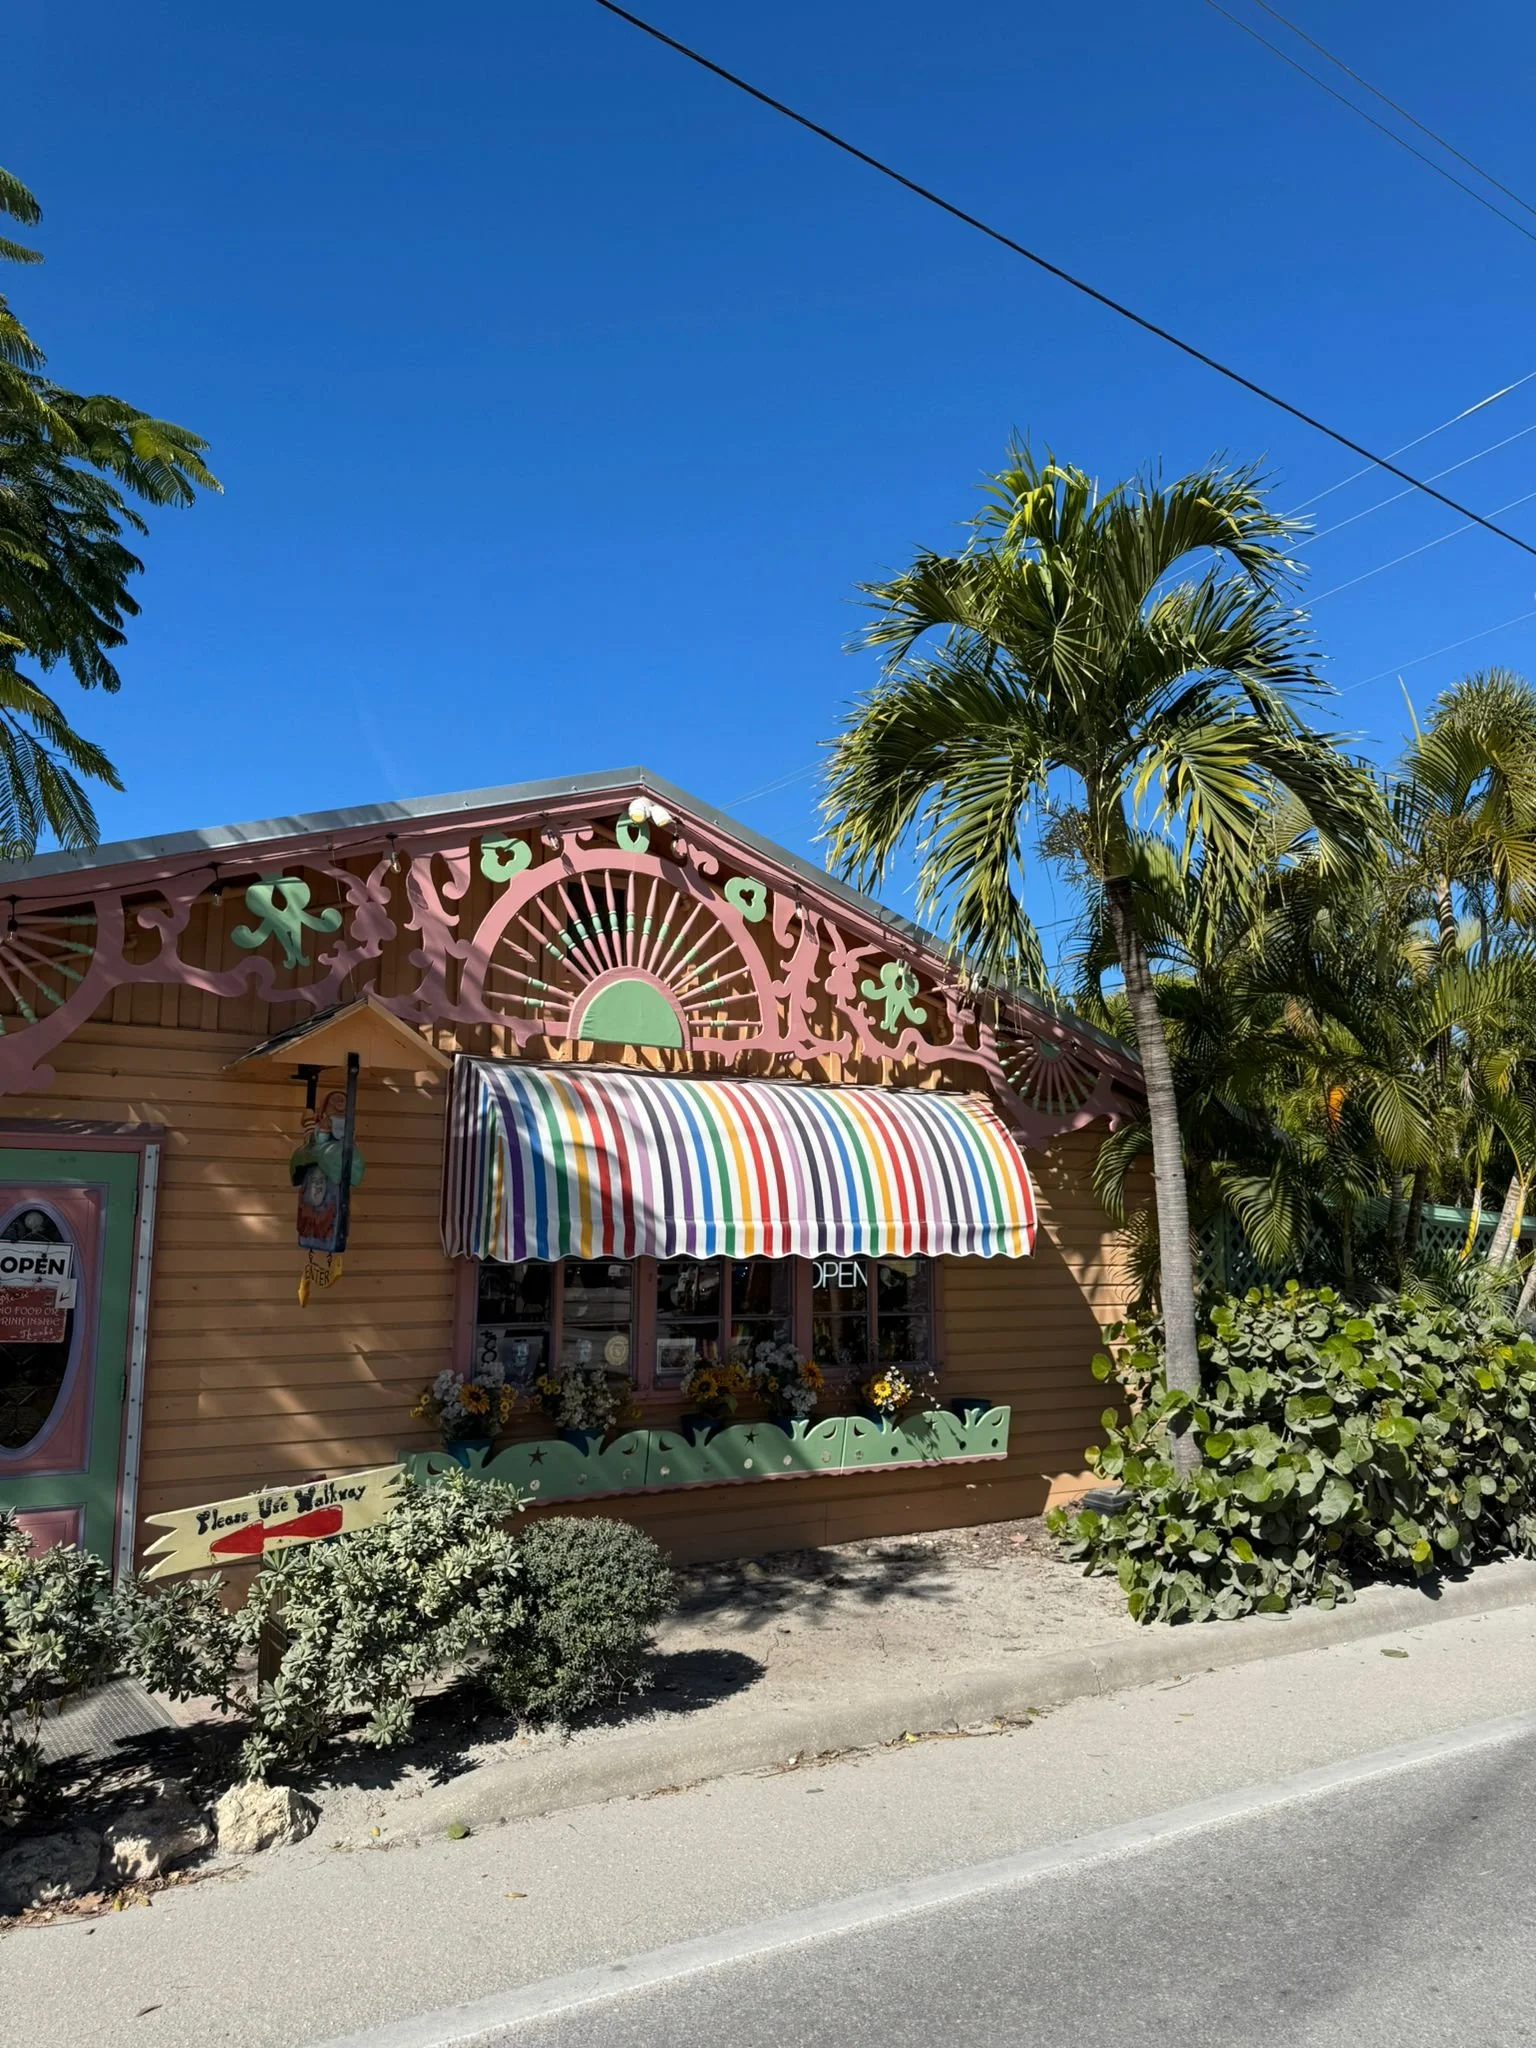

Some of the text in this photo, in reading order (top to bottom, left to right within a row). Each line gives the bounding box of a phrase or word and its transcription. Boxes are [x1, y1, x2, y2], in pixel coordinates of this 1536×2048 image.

[0, 1256, 65, 1275] OPEN
[305, 1263, 330, 1287] ENTER
[15, 1306, 42, 1315] FOOD
[0, 1316, 25, 1327] RINK
[196, 1482, 367, 1535] Please Use Walkway
